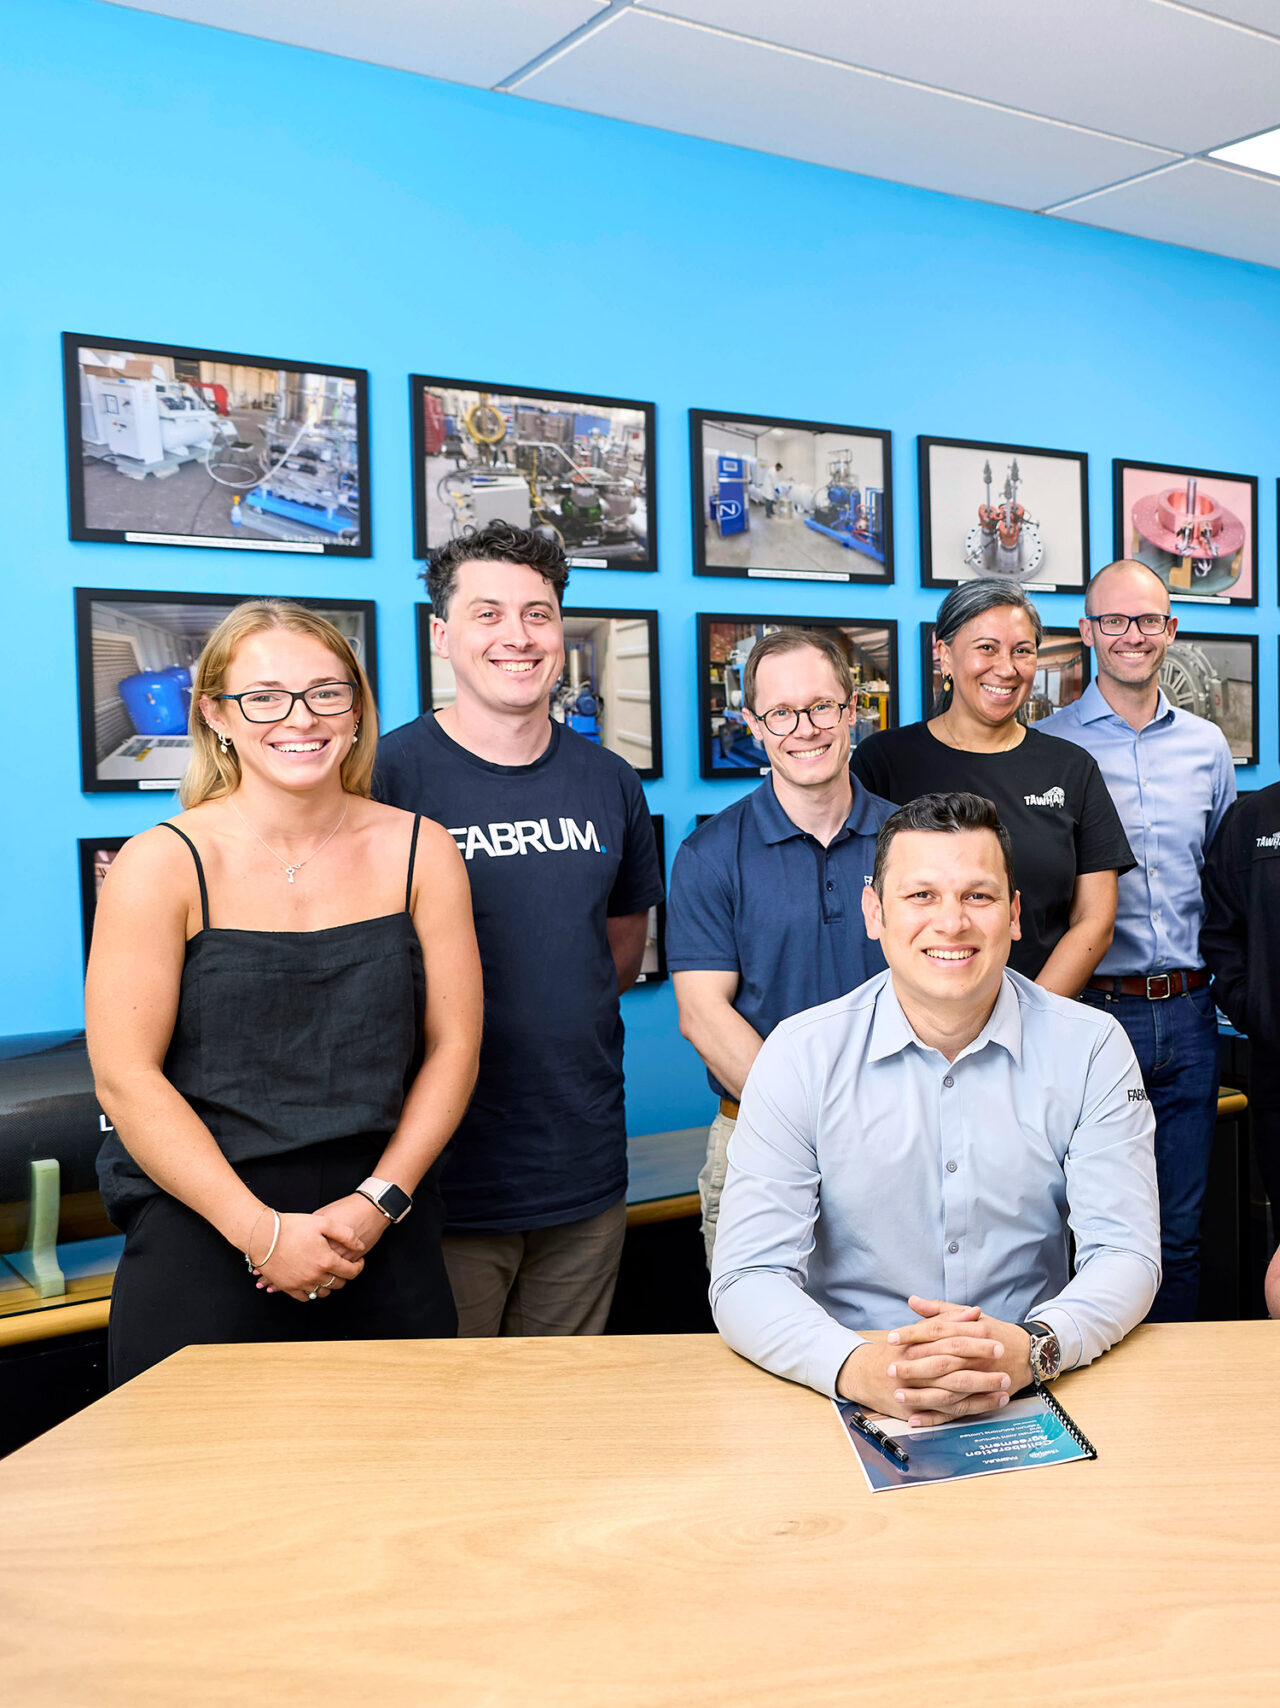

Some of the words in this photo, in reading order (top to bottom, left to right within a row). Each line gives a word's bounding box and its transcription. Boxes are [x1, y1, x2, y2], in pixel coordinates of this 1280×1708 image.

[1023, 794, 1065, 807] TĀWHA
[965, 1440, 1053, 1457] Collaboration
[978, 1434, 1048, 1450] Agreement
